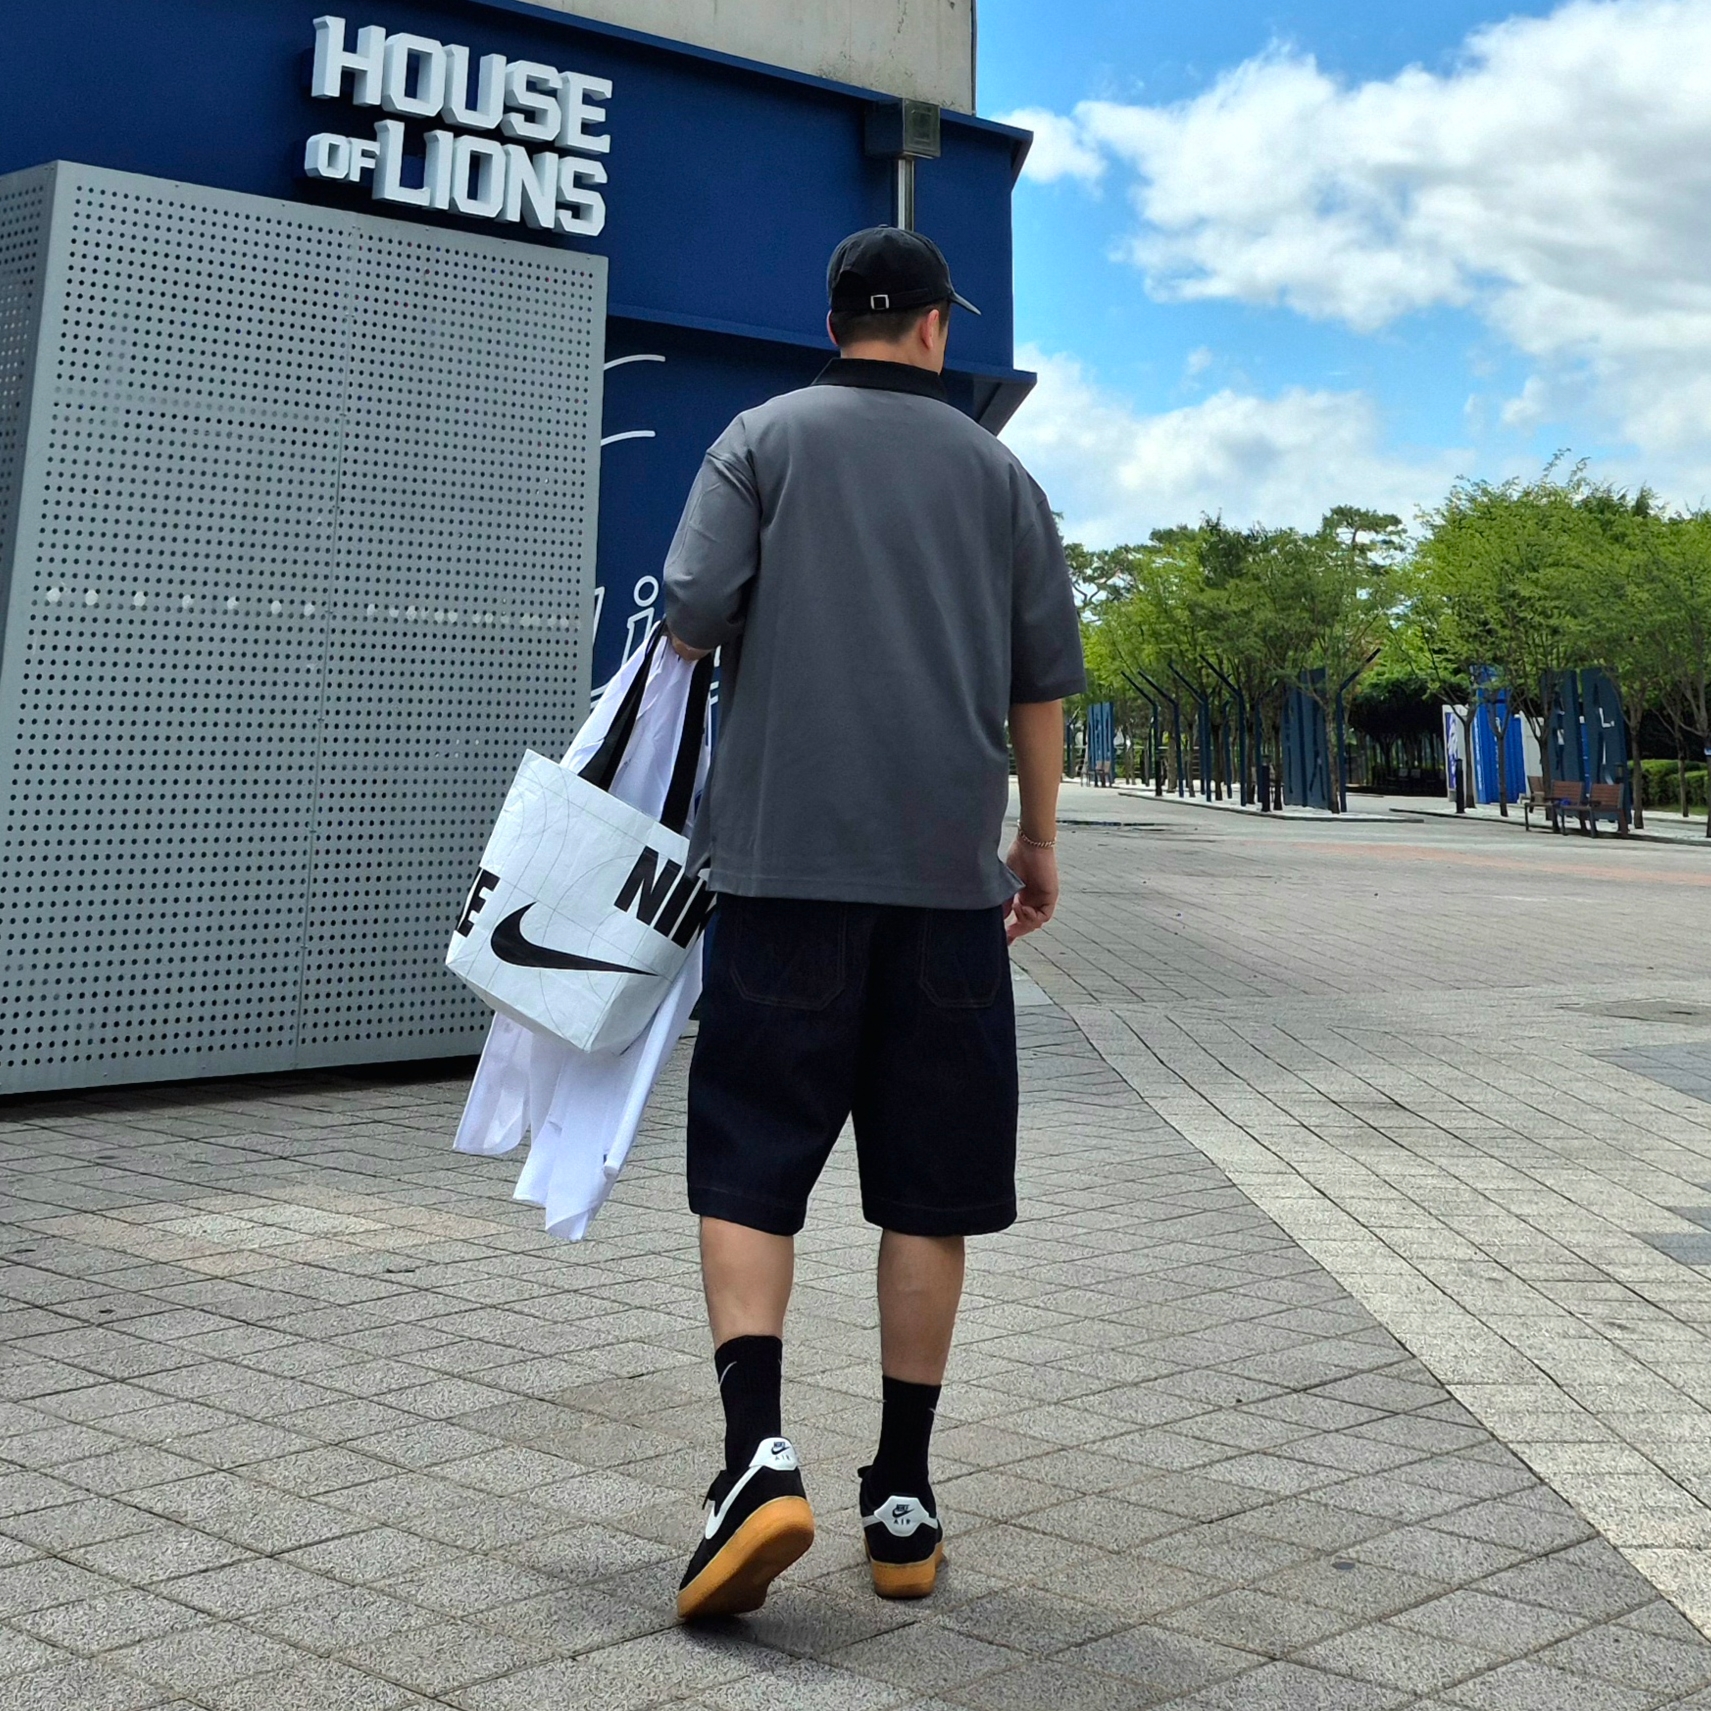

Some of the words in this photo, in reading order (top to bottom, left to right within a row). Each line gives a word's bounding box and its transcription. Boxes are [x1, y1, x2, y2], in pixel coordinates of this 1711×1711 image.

[311, 15, 613, 153] HOUSE
[304, 132, 380, 182] OF
[372, 119, 608, 236] LIONS
[455, 866, 500, 938] E
